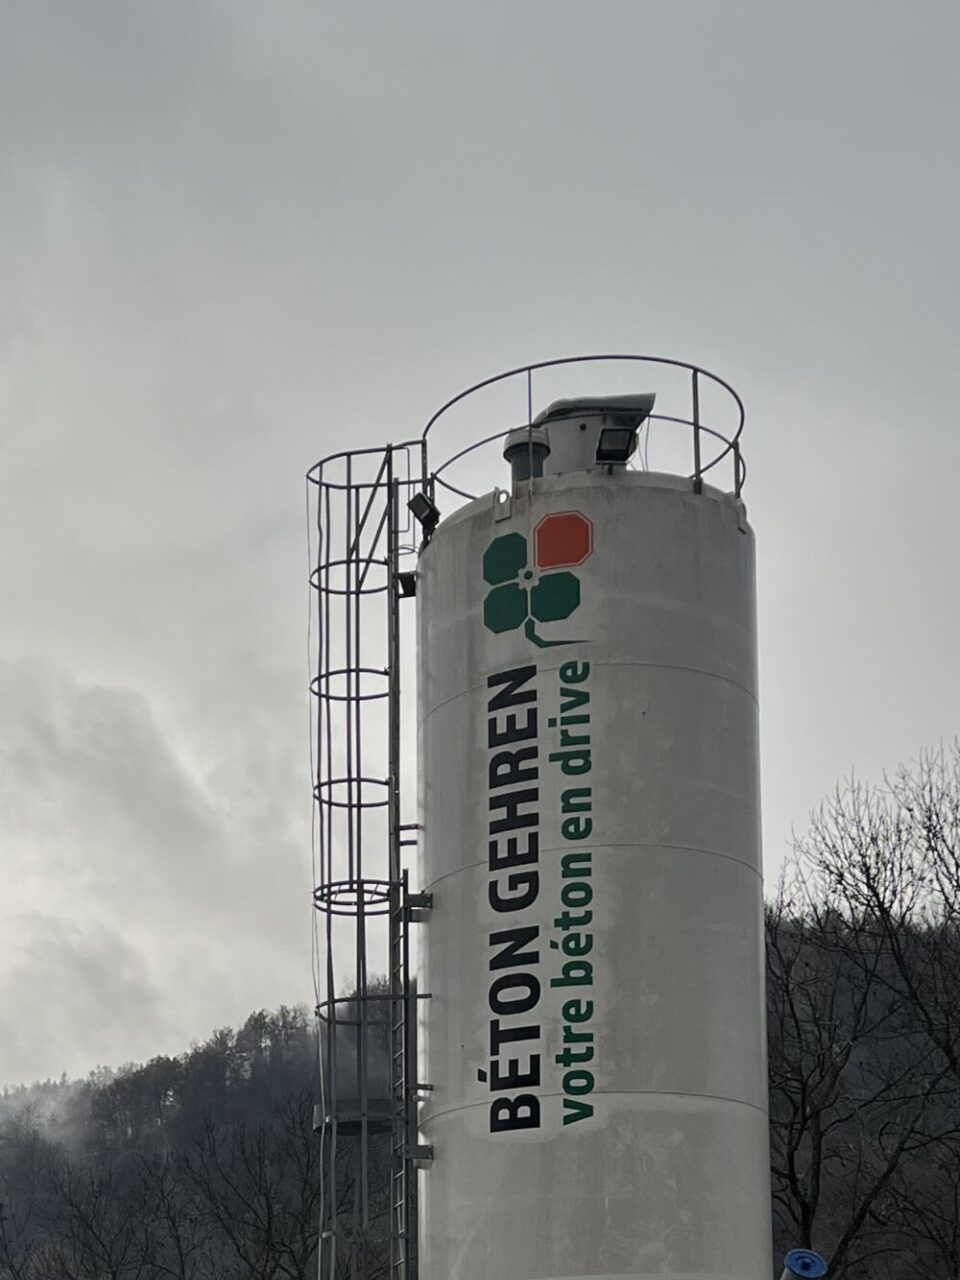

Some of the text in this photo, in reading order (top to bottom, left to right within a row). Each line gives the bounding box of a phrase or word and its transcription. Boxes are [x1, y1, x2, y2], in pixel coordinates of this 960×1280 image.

[477, 664, 541, 1134] BÉTON GEHREN
[548, 660, 594, 1126] votre béton en drive
